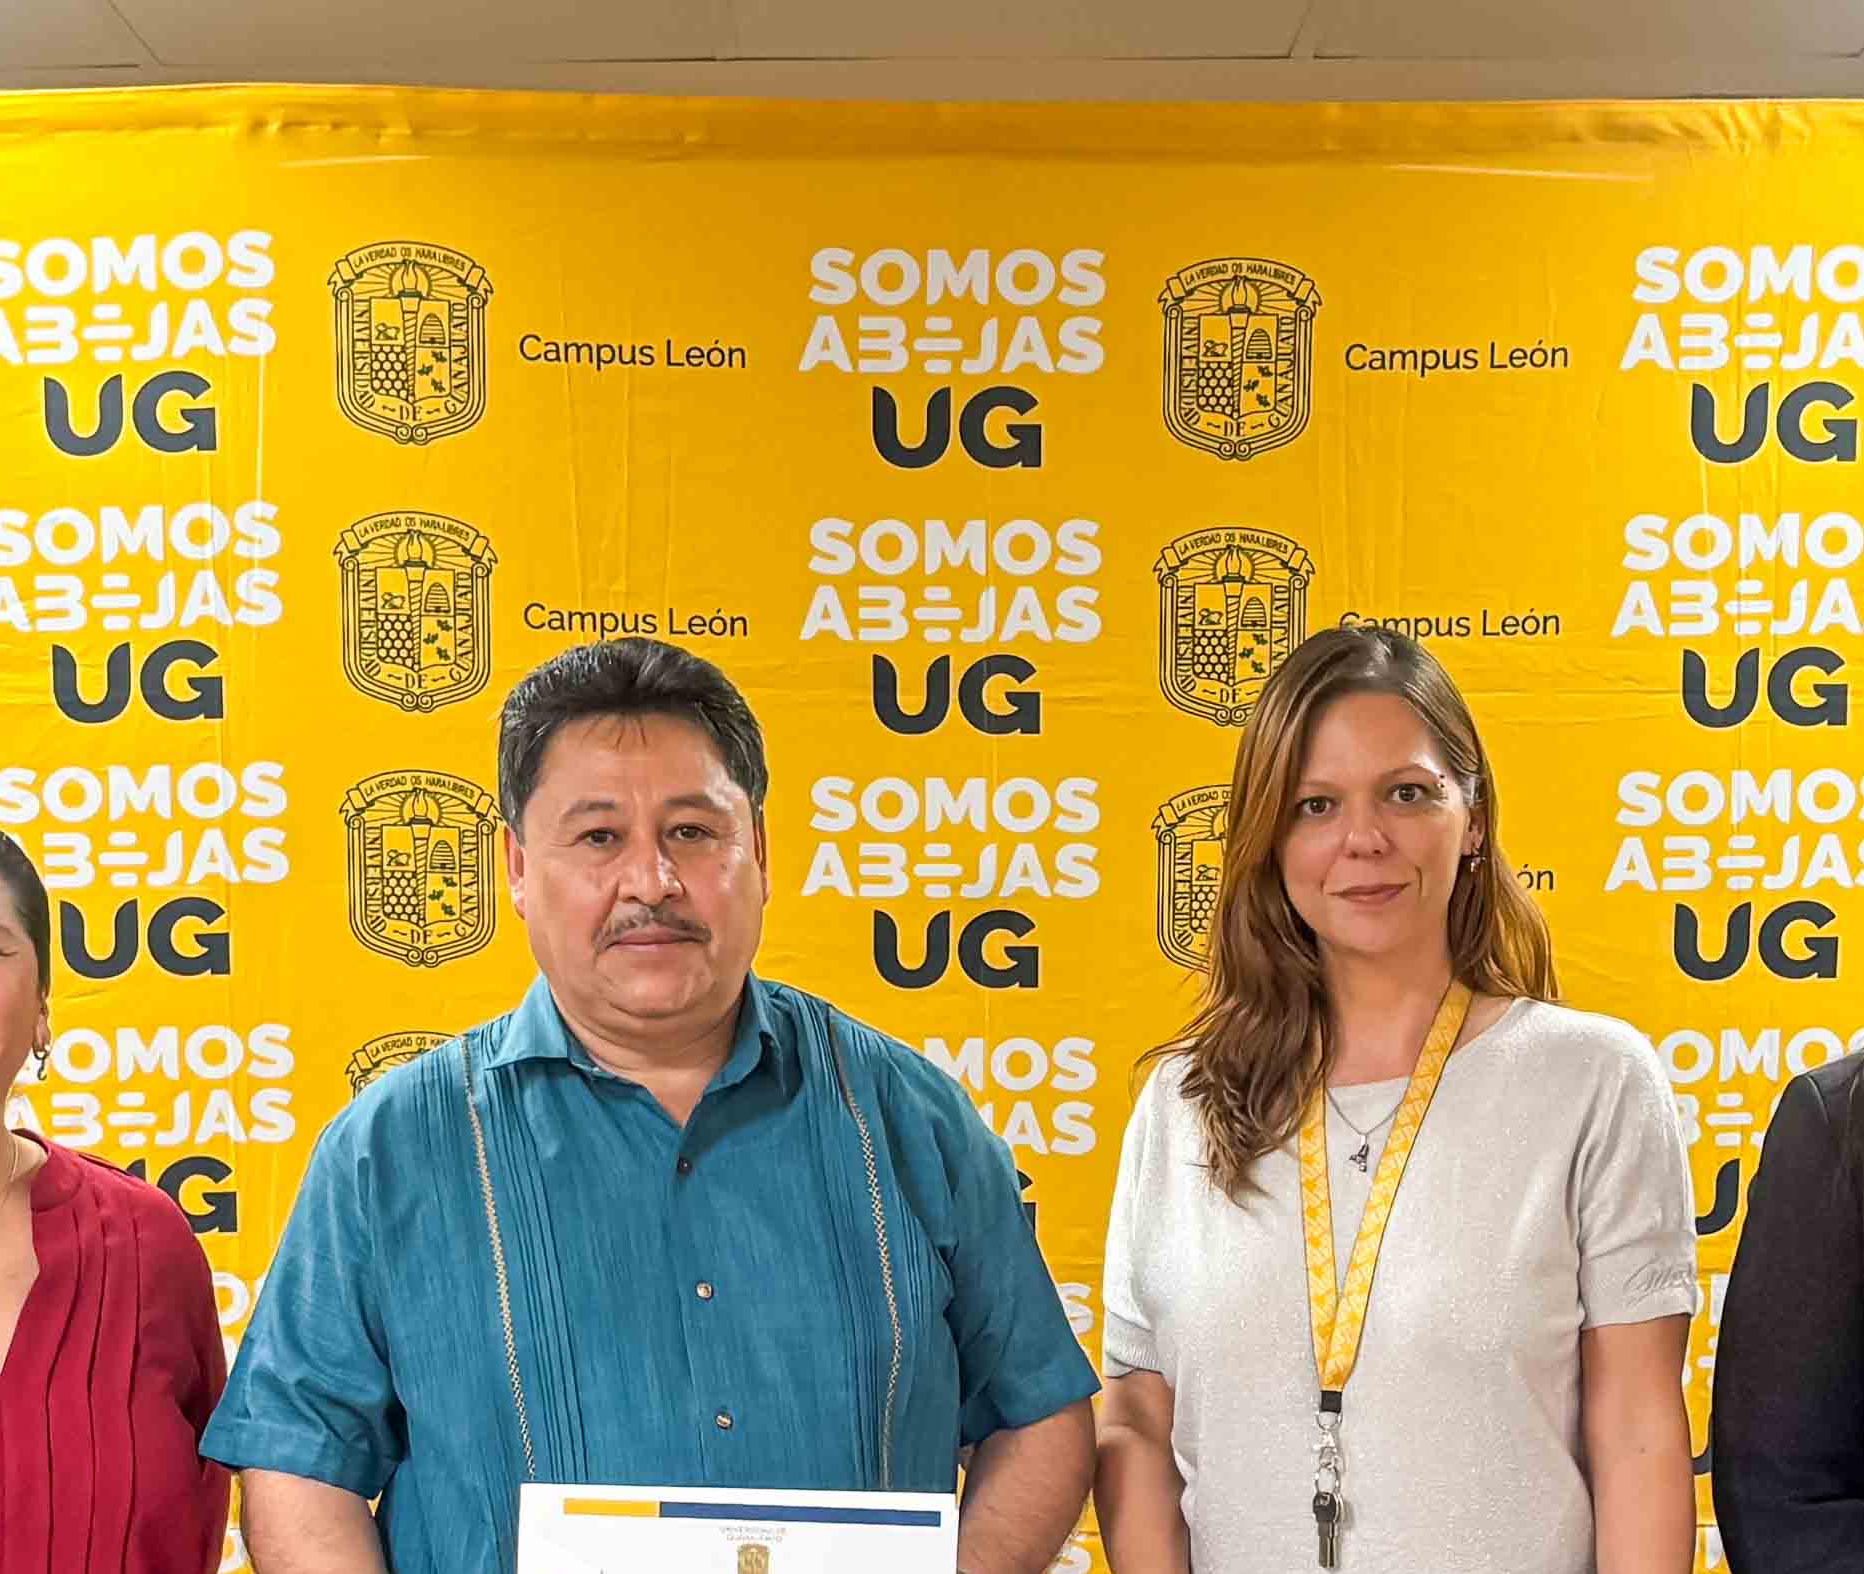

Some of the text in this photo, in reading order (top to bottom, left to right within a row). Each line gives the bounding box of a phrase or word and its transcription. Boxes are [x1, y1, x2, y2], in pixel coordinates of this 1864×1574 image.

[810, 249, 1104, 305] SOMOS
[517, 332, 747, 373] Campus León
[1343, 338, 1570, 380] Campus León
[45, 371, 216, 455] UG
[873, 387, 1041, 468] UG
[1691, 382, 1856, 463] UG
[809, 519, 1101, 575] SOMOS
[522, 601, 749, 641] Campus León
[1480, 607, 1561, 638] León
[53, 640, 223, 723] UG
[873, 655, 1040, 734] UG
[1683, 647, 1847, 727] UG
[811, 777, 1099, 832] SOMOS
[7, 828, 289, 893] BEJAS
[1516, 863, 1555, 891] ón
[61, 897, 230, 978] UG
[874, 910, 1038, 988] UG
[1674, 901, 1838, 980] UG
[923, 1037, 1098, 1094] MOS
[125, 1155, 238, 1233] G
